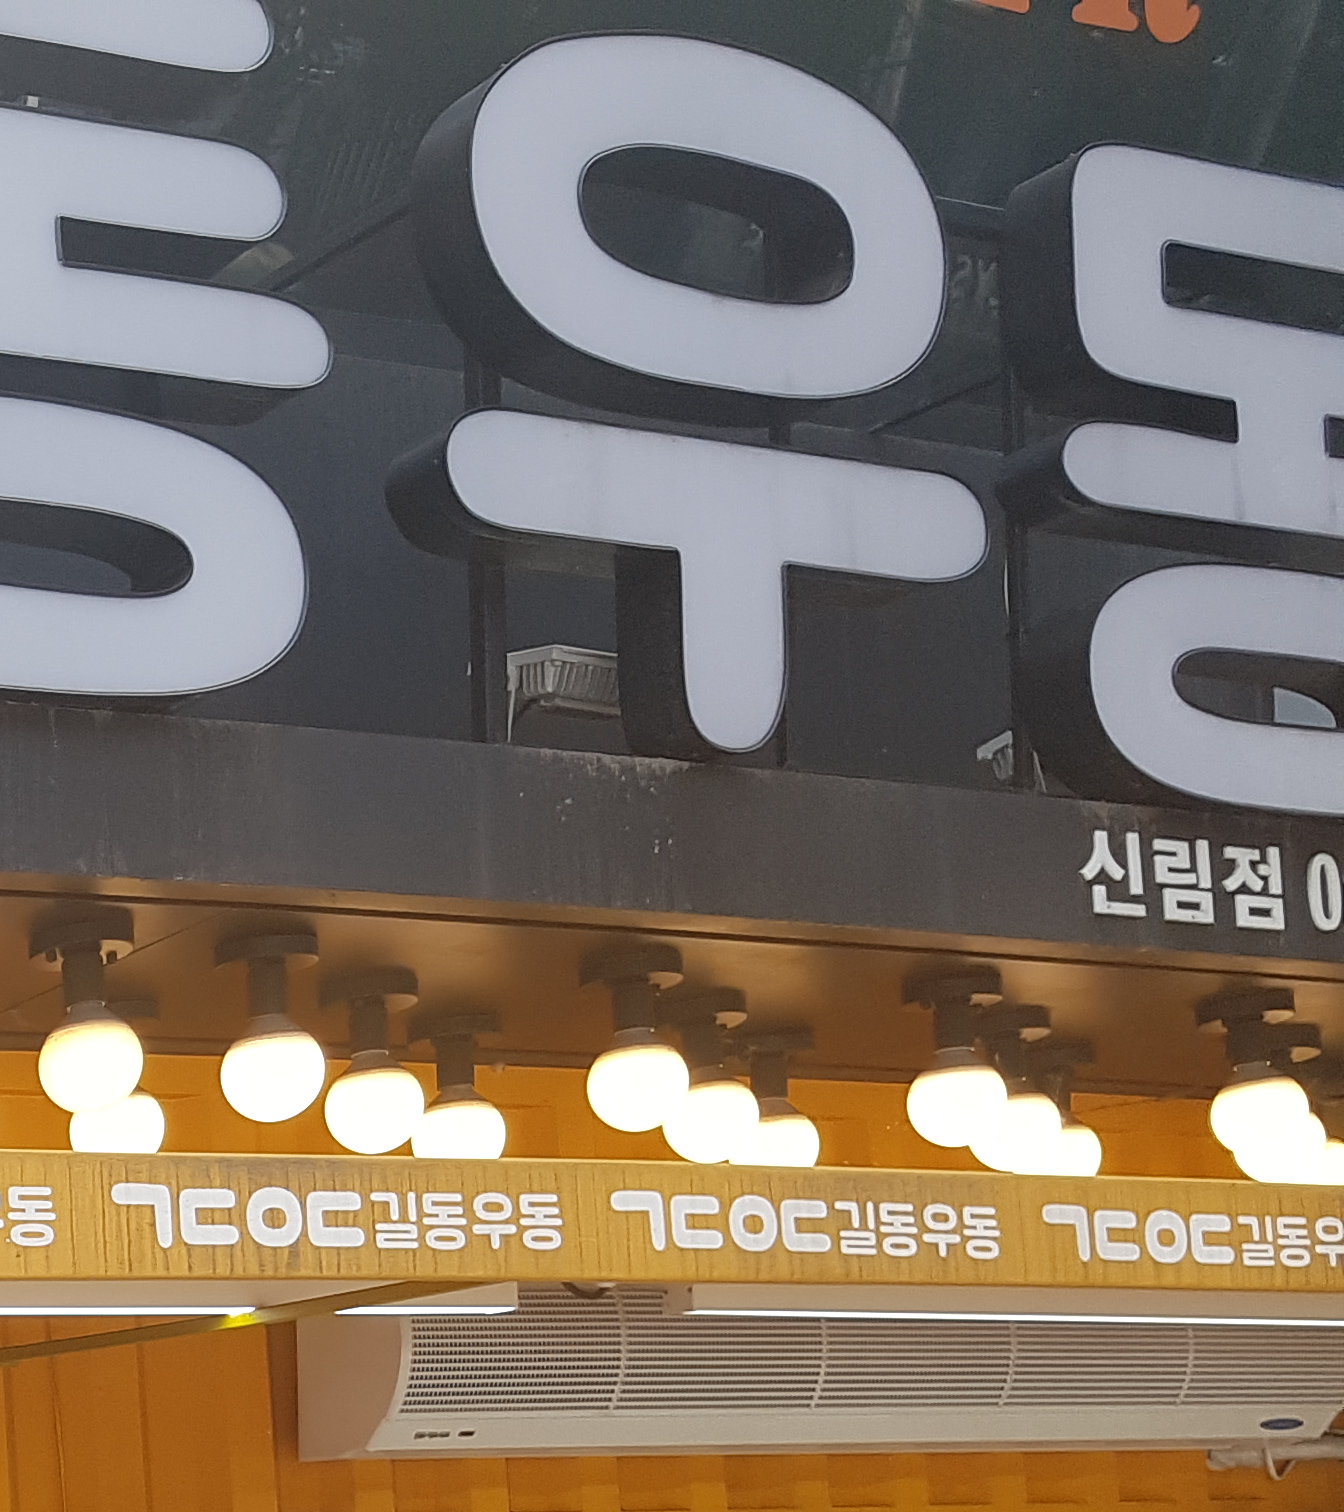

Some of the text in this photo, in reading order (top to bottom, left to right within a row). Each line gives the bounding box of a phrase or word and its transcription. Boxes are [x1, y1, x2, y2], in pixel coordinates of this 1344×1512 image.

[1079, 830, 1285, 930] 신림점
[369, 1191, 564, 1251] 길동우동
[834, 1200, 1001, 1260] 길동우동
